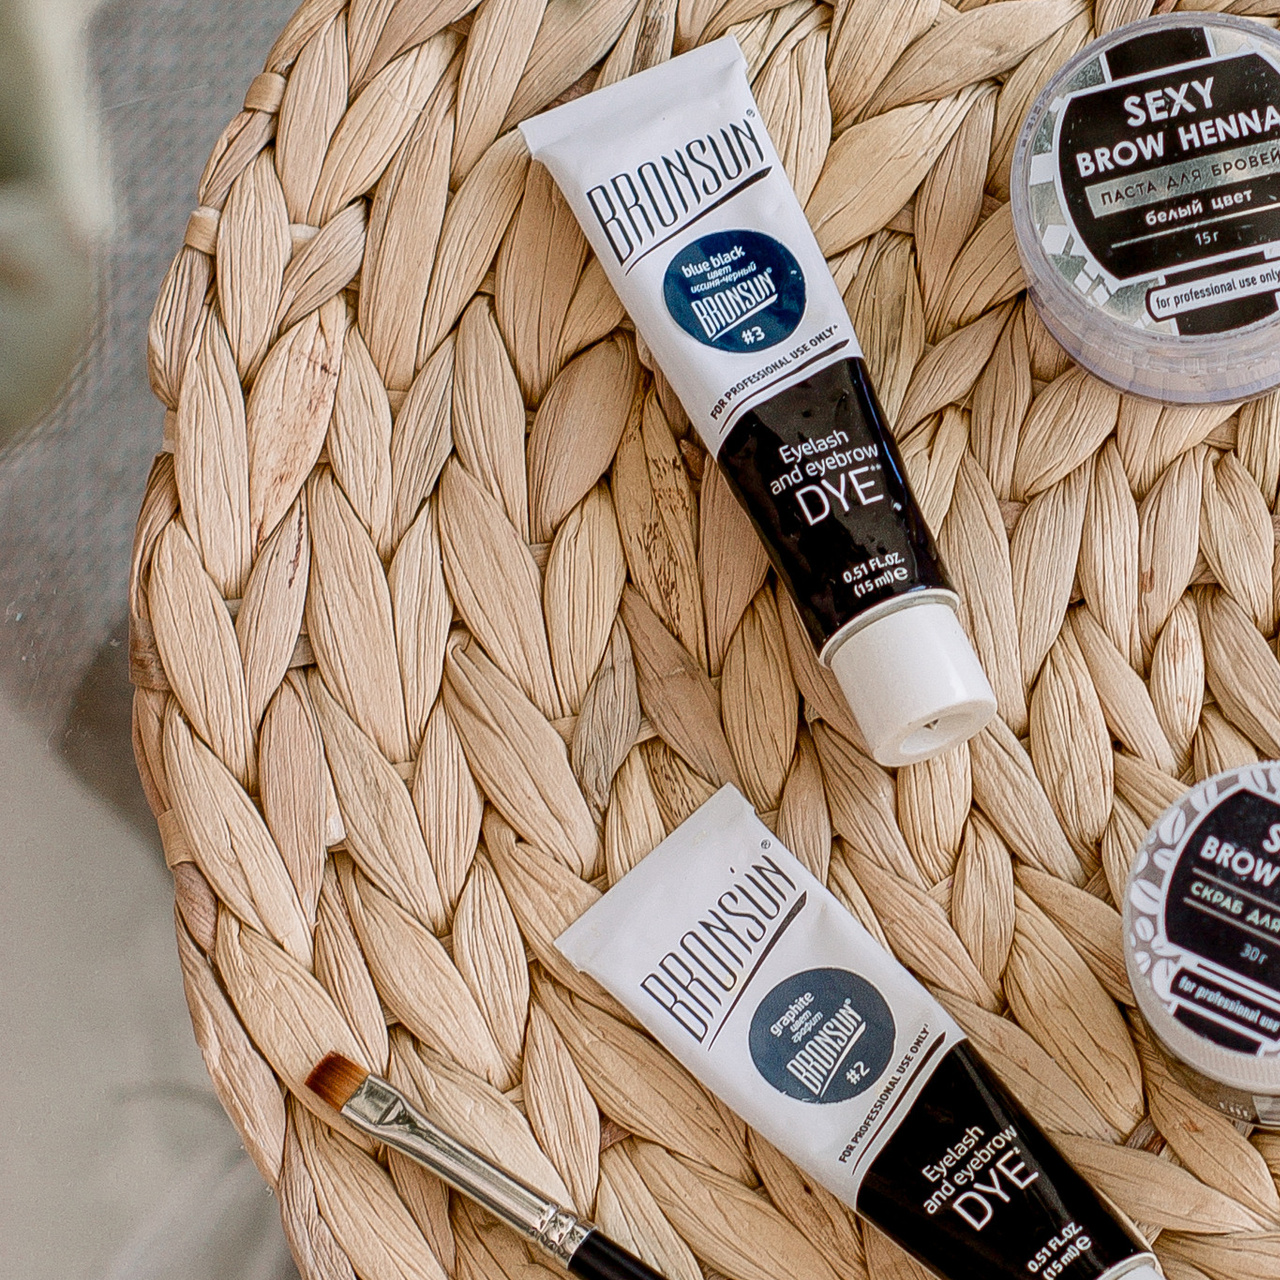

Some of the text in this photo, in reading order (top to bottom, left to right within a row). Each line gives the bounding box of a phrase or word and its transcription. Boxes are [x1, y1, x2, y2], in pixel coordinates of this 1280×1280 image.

[1123, 77, 1214, 128] SEXY
[1076, 132, 1165, 177] BROW
[586, 119, 764, 267] BRONSUN
[1101, 181, 1157, 206] ПАСТА
[1167, 169, 1201, 189] ДЛЯ
[1145, 189, 1253, 226] белый цвет
[681, 245, 746, 279] blue black
[707, 264, 732, 280] цвет
[690, 271, 776, 339] BRONSUN
[1156, 294, 1172, 310] for
[1173, 278, 1238, 309] professional
[1239, 276, 1258, 290] use
[741, 326, 765, 345] #3
[710, 398, 727, 421] FOR
[726, 356, 792, 400] PROFESSIONAL
[790, 343, 811, 360] USE
[778, 429, 849, 464] Eyelash
[770, 443, 879, 496] and eyebrow
[843, 565, 869, 584] 0.51
[853, 580, 874, 598] (15
[1200, 835, 1280, 887] BROW
[1190, 881, 1244, 914] СКРАБ
[640, 854, 797, 1044] BRONSUN
[770, 992, 815, 1037] graphite
[1179, 976, 1197, 993] for
[1194, 986, 1261, 1023] professional
[786, 1003, 862, 1095] BRONSUN
[846, 1061, 870, 1085] #2
[838, 1143, 855, 1163] FOR
[852, 1075, 901, 1145] PROFESSIONAL
[899, 1054, 914, 1076] USE
[921, 1125, 985, 1183] Eyelash
[923, 1125, 1018, 1214] and eyebrow
[1027, 1246, 1052, 1273] 0.51
